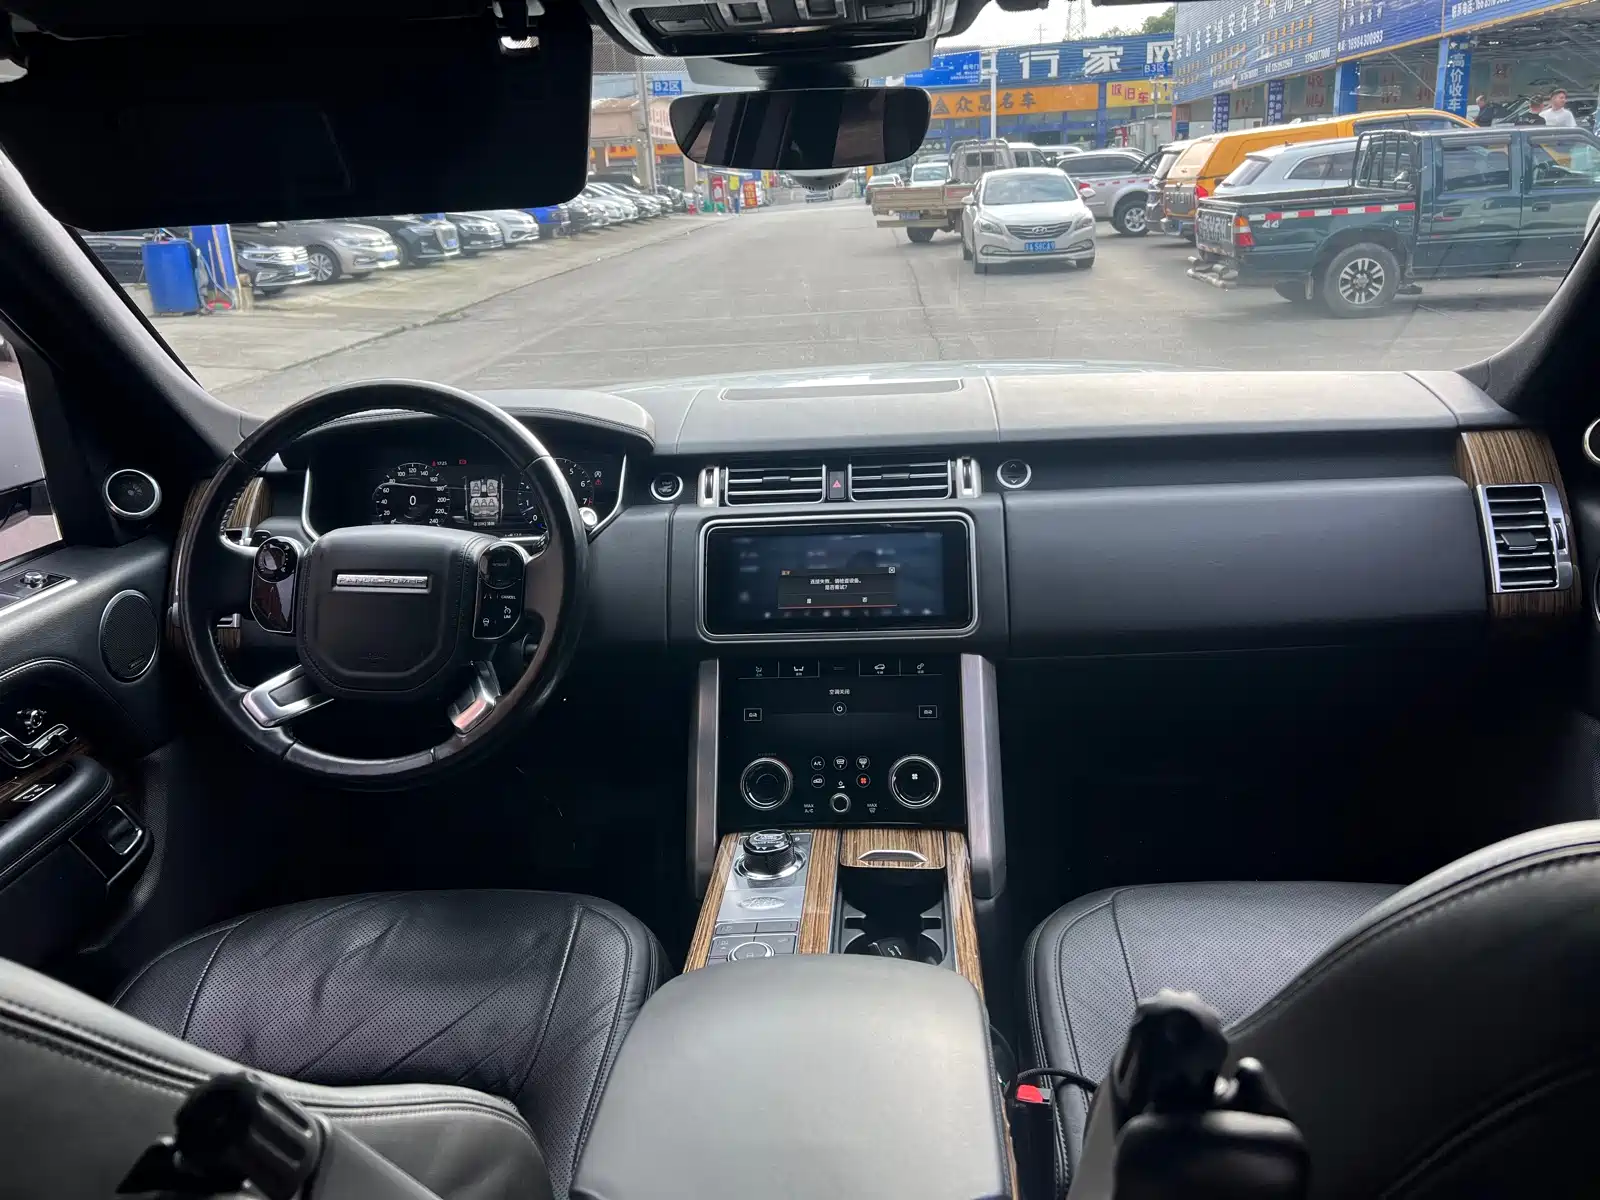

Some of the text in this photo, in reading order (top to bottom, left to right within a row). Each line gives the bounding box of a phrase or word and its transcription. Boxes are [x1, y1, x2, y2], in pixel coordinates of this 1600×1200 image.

[1144, 62, 1166, 73] B3区
[654, 81, 681, 92] B2区
[1448, 53, 1466, 111] 高价收车
[580, 480, 586, 488] 6
[409, 495, 417, 506] 0
[582, 497, 588, 505] 7
[532, 514, 538, 522] 0
